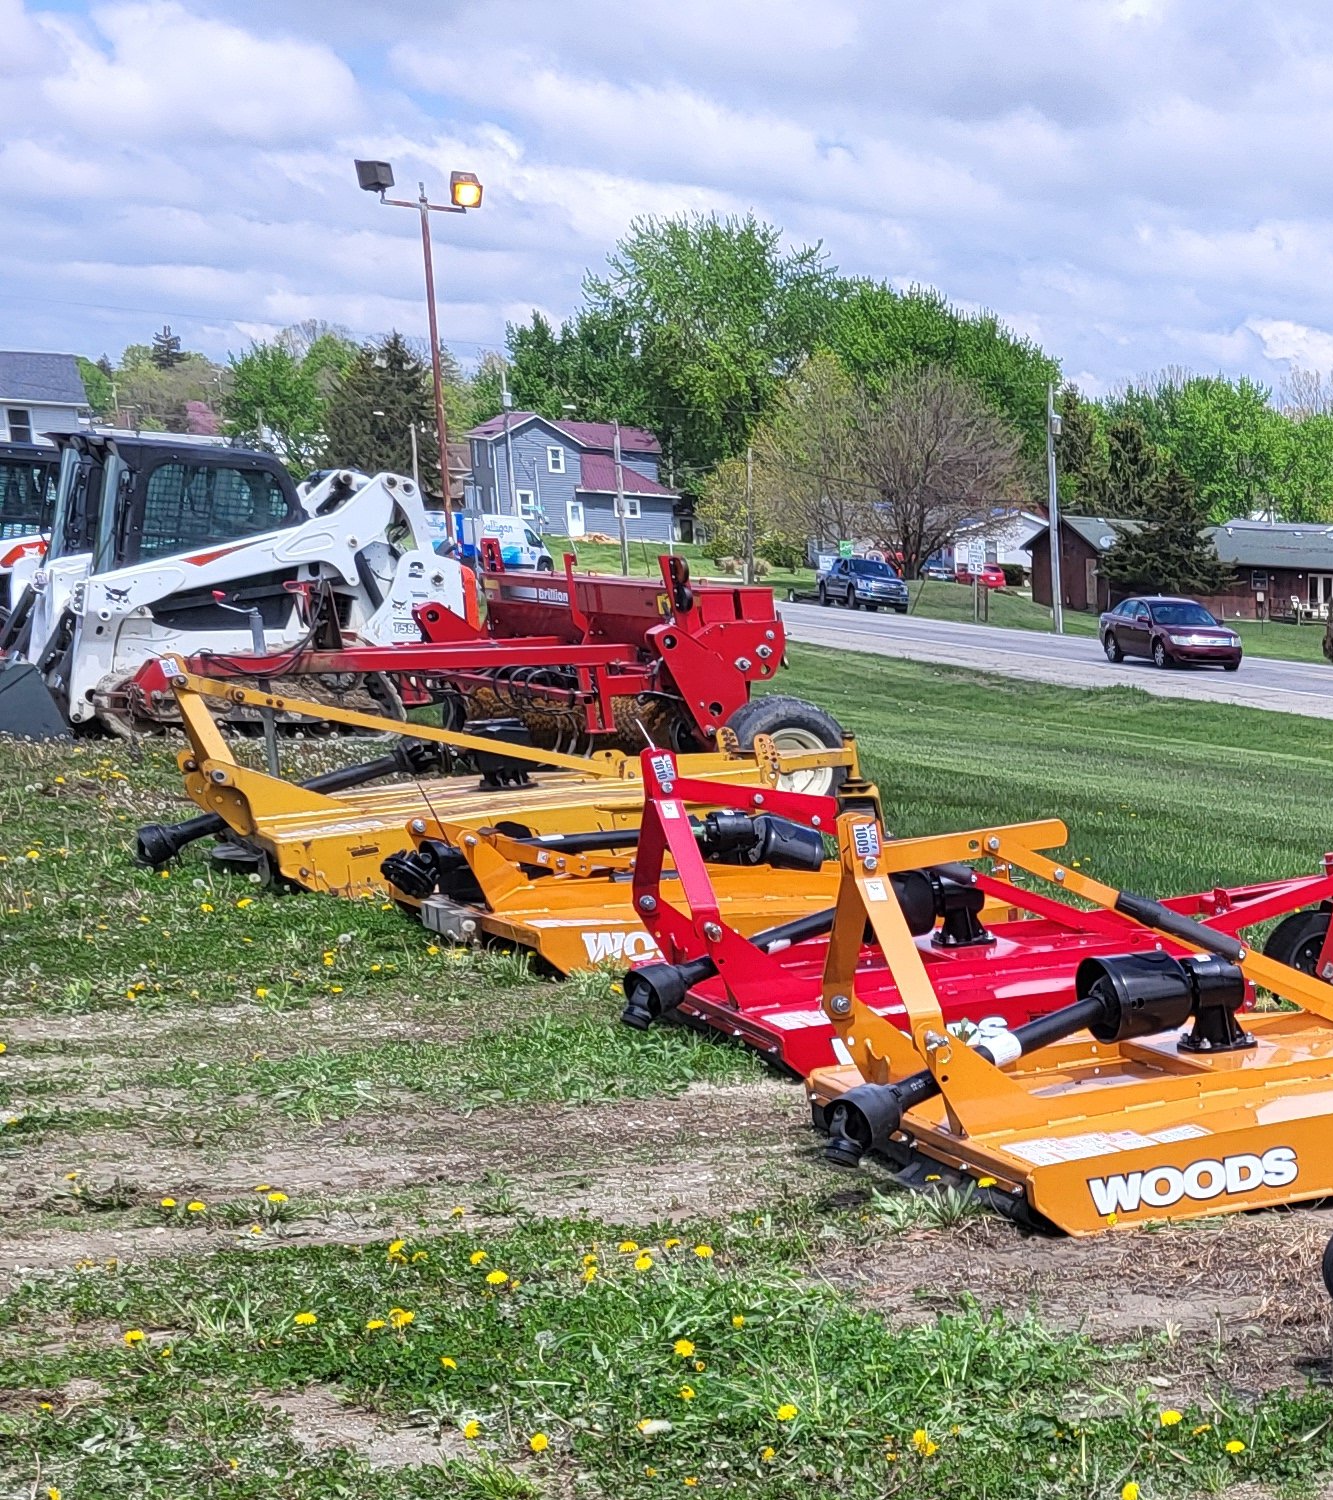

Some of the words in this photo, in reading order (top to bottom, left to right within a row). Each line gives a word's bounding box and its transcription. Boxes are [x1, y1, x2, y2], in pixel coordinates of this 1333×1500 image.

[970, 564, 983, 573] 35
[538, 588, 569, 602] Brillion
[654, 760, 667, 780] 1010
[855, 827, 870, 854] 1009
[869, 830, 877, 844] LOT
[1087, 1146, 1299, 1217] WOODS
